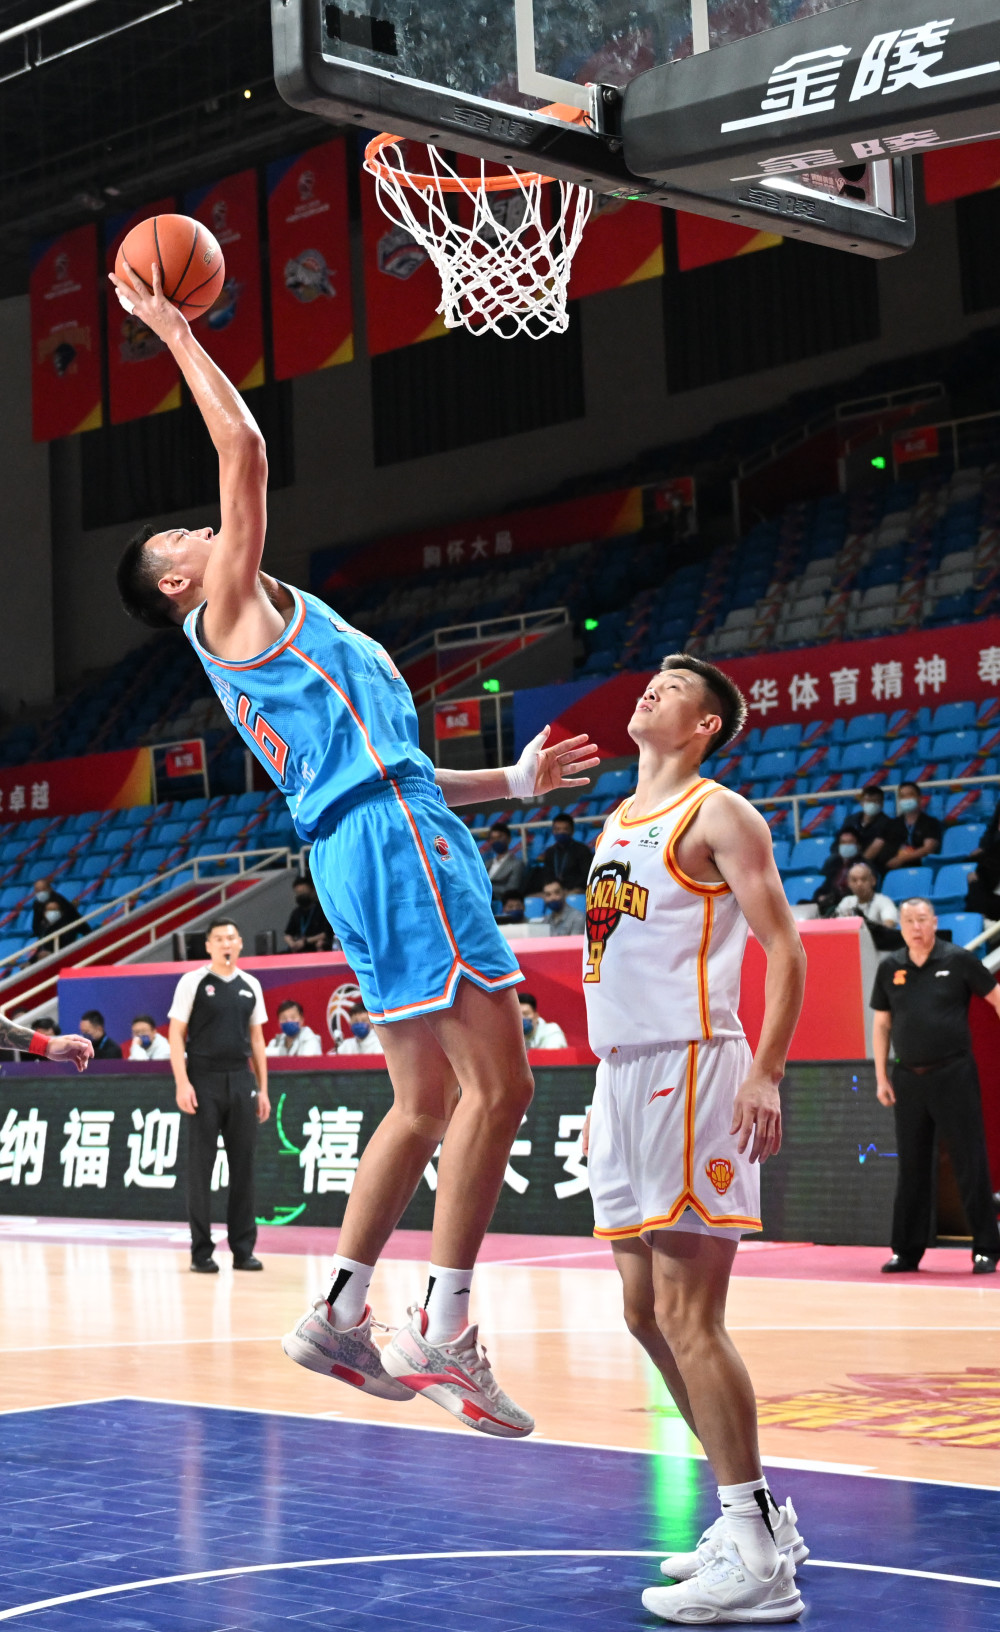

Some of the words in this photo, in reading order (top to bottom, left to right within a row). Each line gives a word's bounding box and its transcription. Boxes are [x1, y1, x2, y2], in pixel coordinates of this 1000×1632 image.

[721, 18, 1000, 133] 金陵
[748, 653, 946, 716] 华体育精神
[0, 780, 50, 814] 卓越
[583, 938, 604, 984] 9
[0, 1107, 230, 1192] 纳福迎
